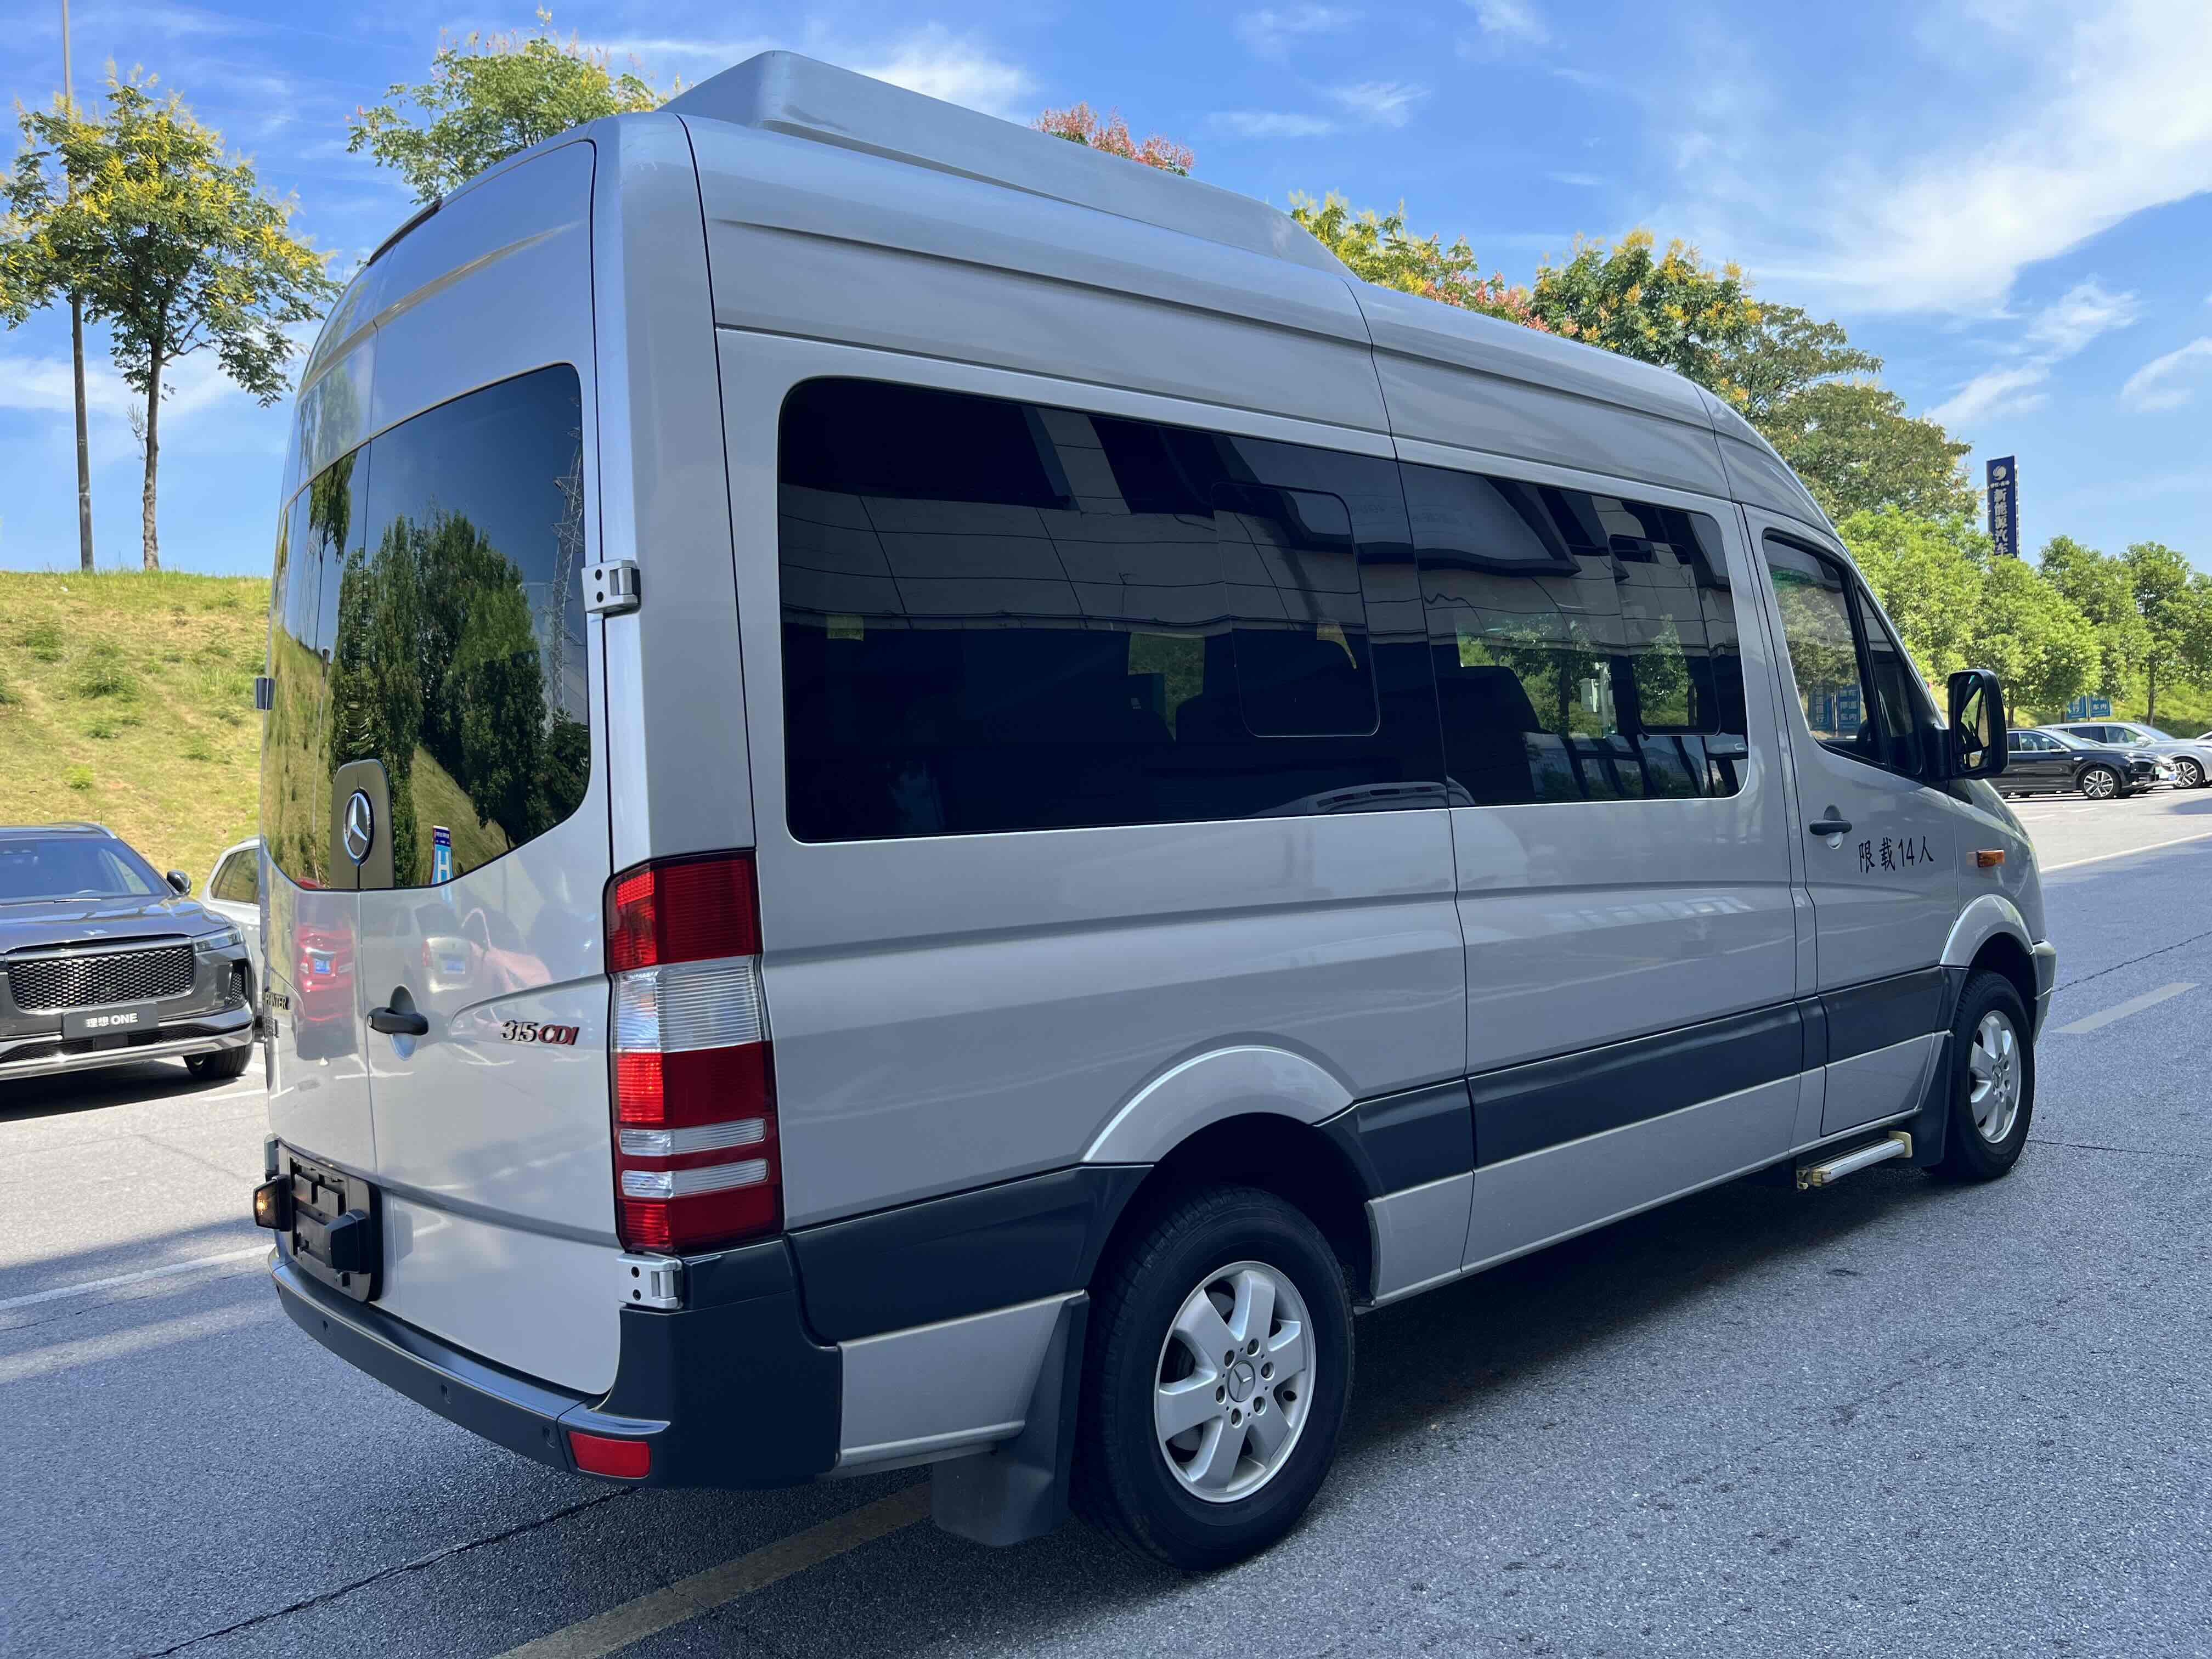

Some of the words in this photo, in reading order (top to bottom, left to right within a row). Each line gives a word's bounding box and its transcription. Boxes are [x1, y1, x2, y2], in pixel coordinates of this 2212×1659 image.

[1994, 487, 2008, 556] 新能源汽车
[1858, 836, 1934, 874] 限载14人
[86, 1017, 109, 1028] 理想
[111, 1013, 138, 1025] ONE
